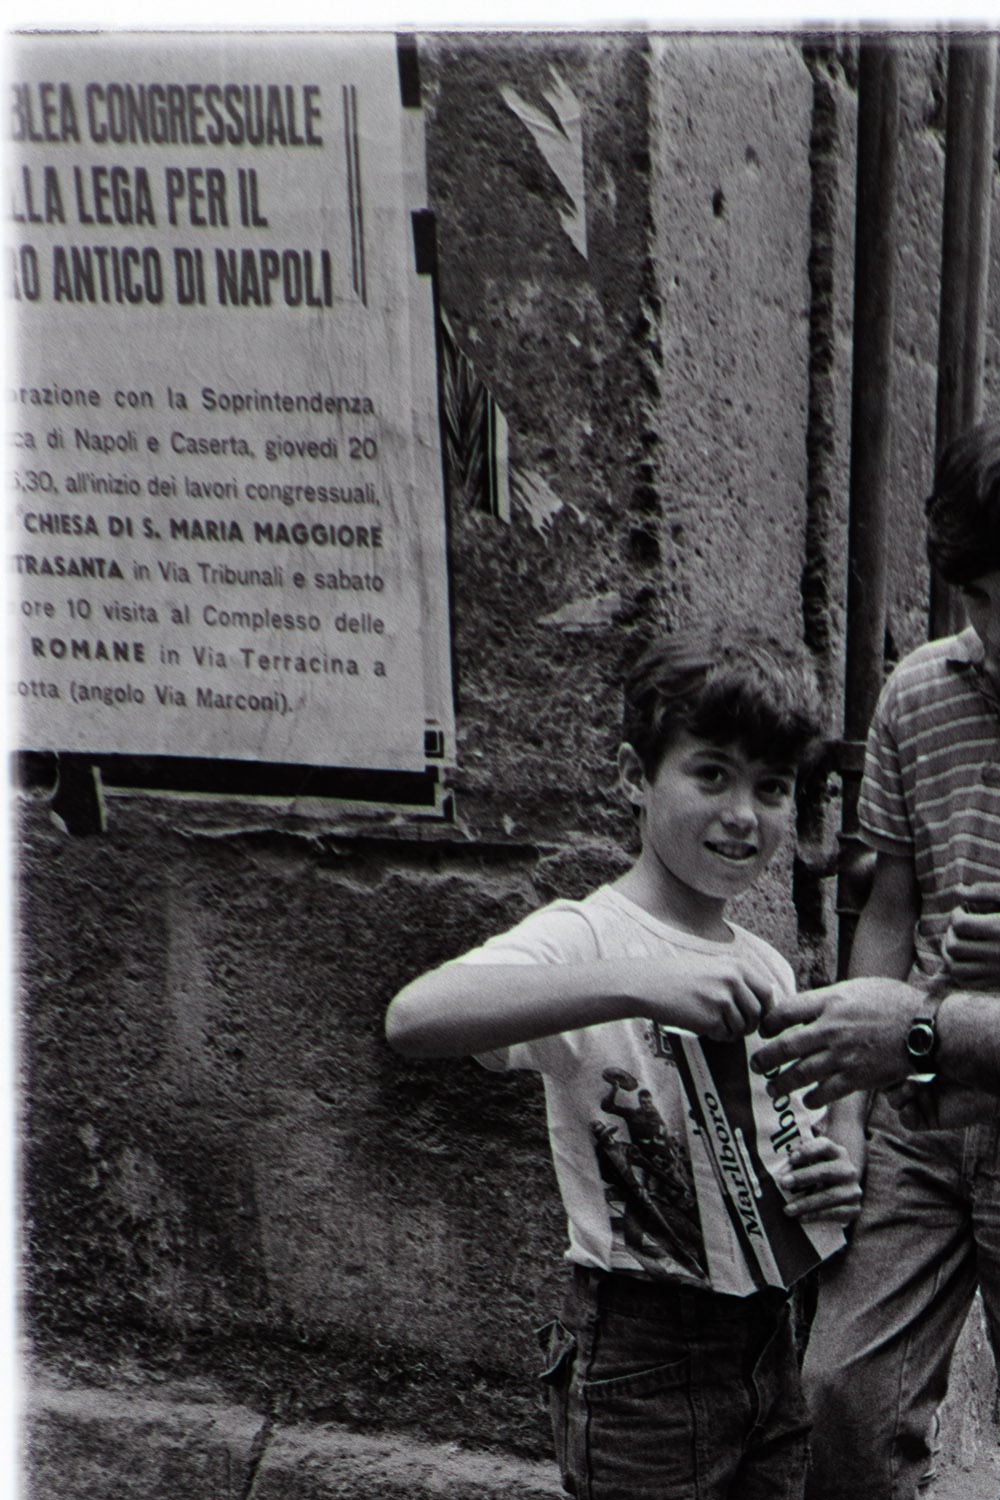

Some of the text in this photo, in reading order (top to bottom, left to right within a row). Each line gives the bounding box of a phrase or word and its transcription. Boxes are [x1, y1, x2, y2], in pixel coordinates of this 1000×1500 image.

[85, 83, 323, 146] CONGRESSUALE
[73, 165, 156, 225] LEGA
[165, 167, 229, 227] PER
[238, 167, 268, 228] IL
[52, 246, 165, 306] ANTICO
[175, 248, 207, 306] DI
[214, 248, 334, 308] NAPOLI
[114, 390, 154, 409] con
[166, 386, 188, 410] la
[201, 388, 376, 416] Soprintendenza
[46, 428, 64, 450] di
[74, 428, 138, 454] Napoli
[146, 435, 160, 453] e
[348, 436, 377, 460] 20
[65, 472, 141, 496] all'inizio
[148, 476, 176, 497] dei
[184, 477, 238, 498] lavori
[24, 512, 383, 548] CHIESA DI S. MARIA MAGGIORE
[133, 560, 151, 581] in
[157, 560, 190, 584] Via
[198, 563, 283, 587] Tribunali
[292, 570, 306, 589] e
[314, 569, 385, 592] sabato
[21, 598, 385, 634] ore 10 visita al Complesso delle
[31, 636, 386, 677] ROMANE in Via Terracina a
[70, 680, 145, 706] (angolo
[154, 683, 187, 707] Via
[196, 687, 293, 715] Marconi).
[704, 1091, 763, 1239] Marlboro
